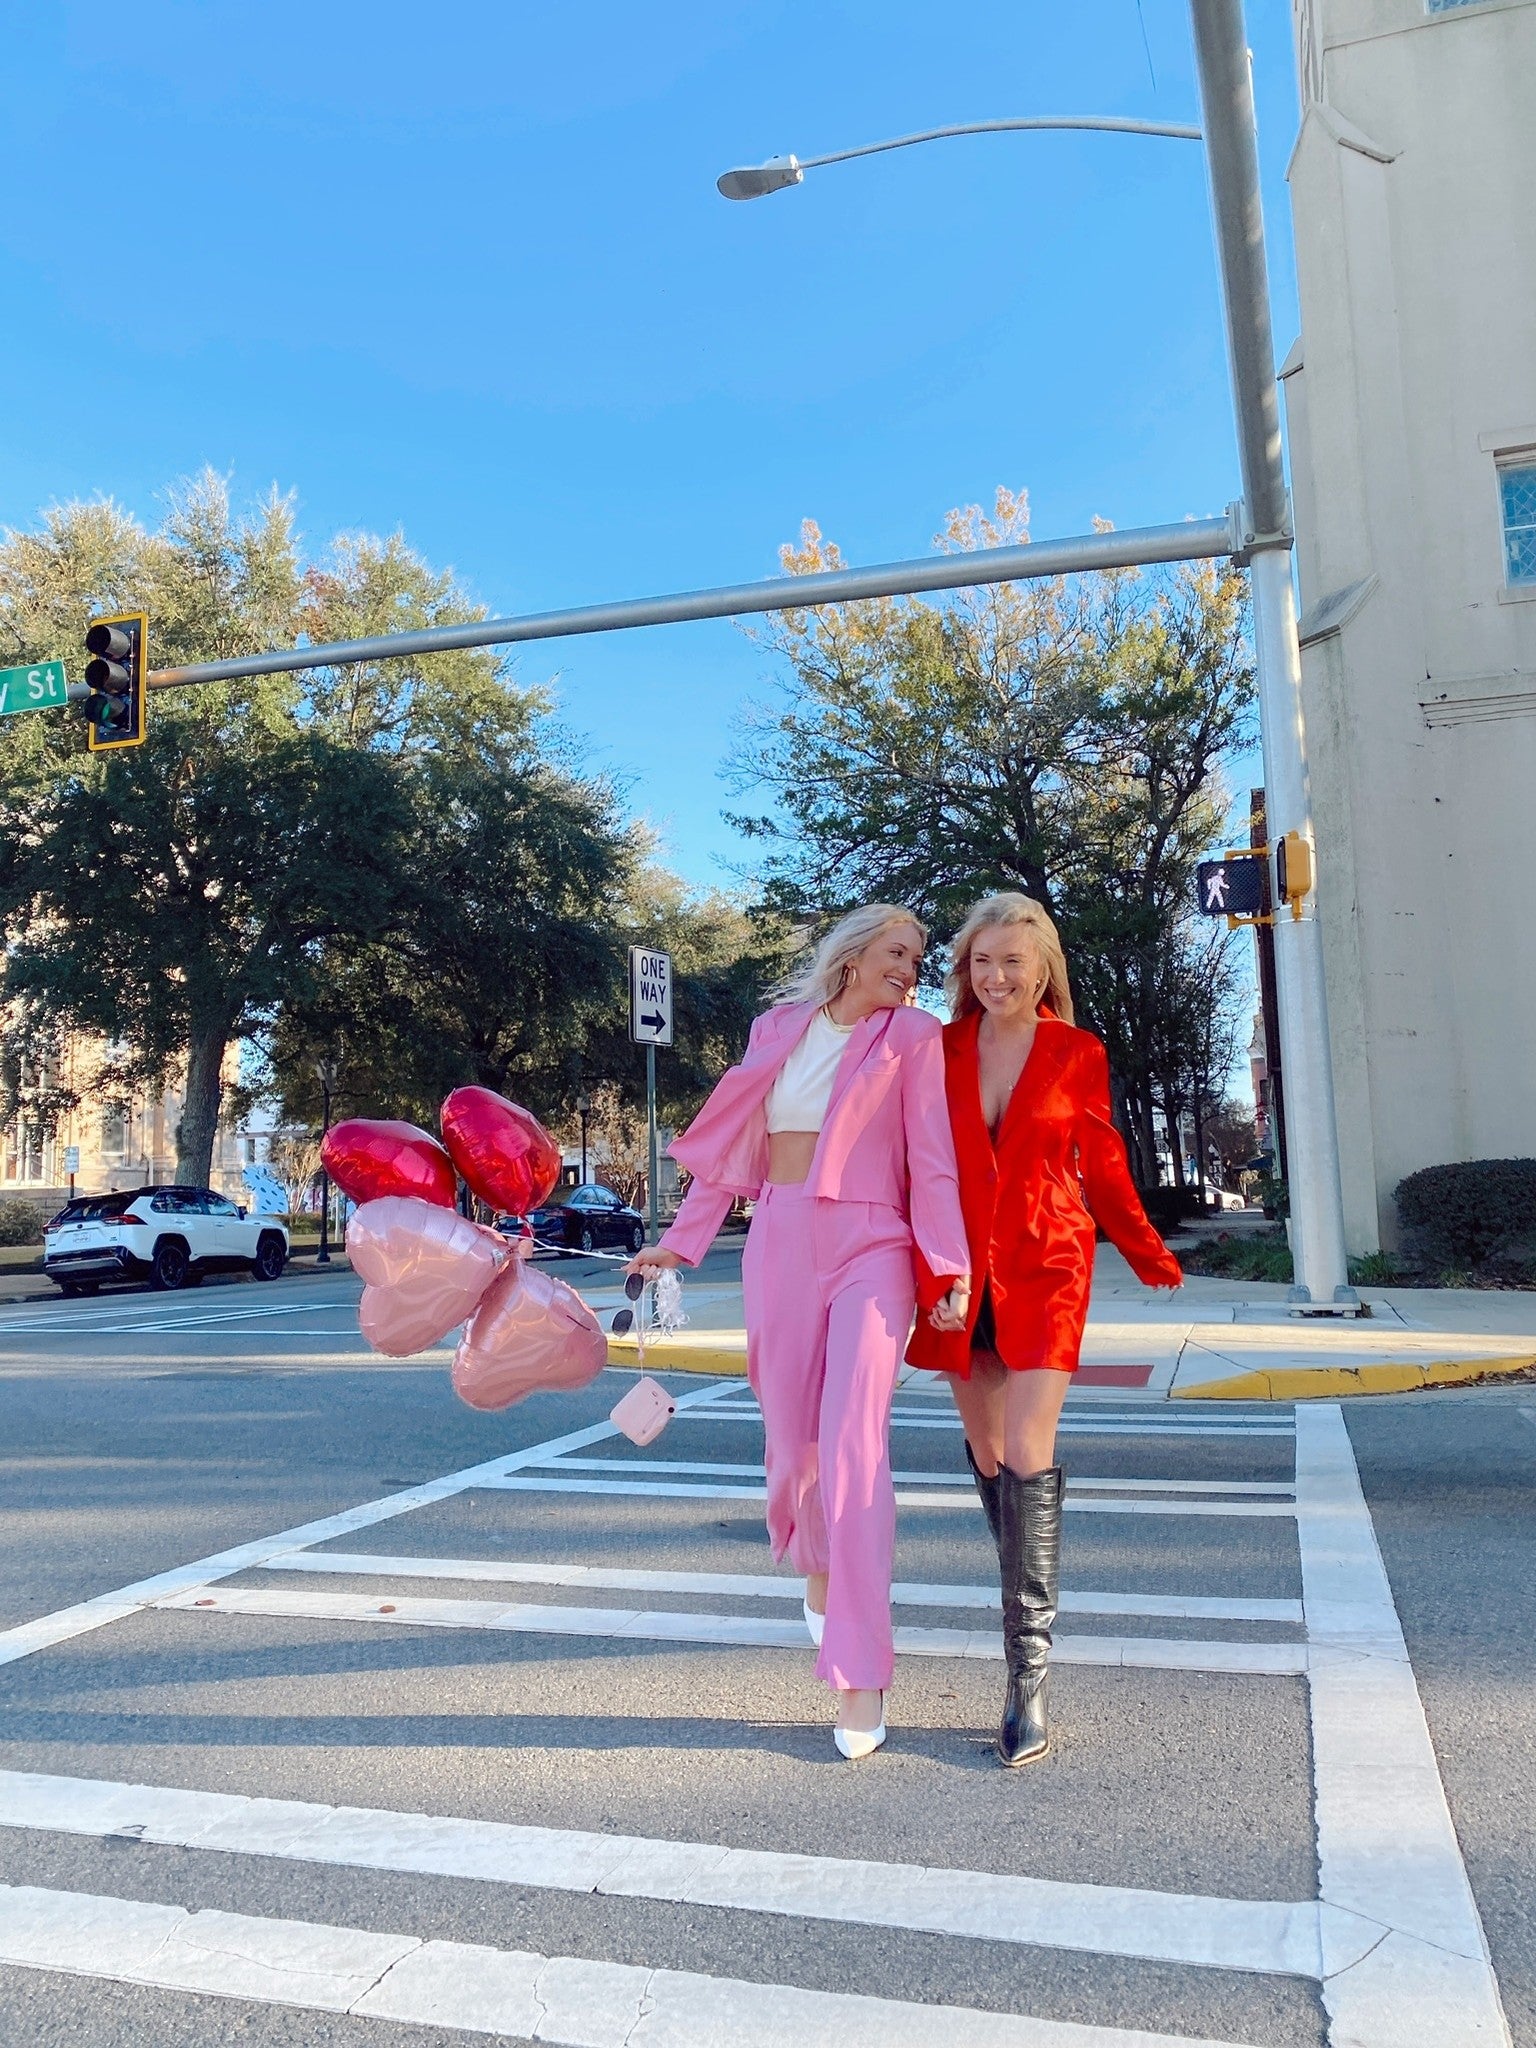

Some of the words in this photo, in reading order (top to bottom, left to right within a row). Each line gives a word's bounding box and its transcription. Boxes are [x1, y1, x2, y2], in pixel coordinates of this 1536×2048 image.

[27, 668, 57, 700] St
[641, 956, 666, 980] ONE
[640, 981, 666, 1004] WAY
